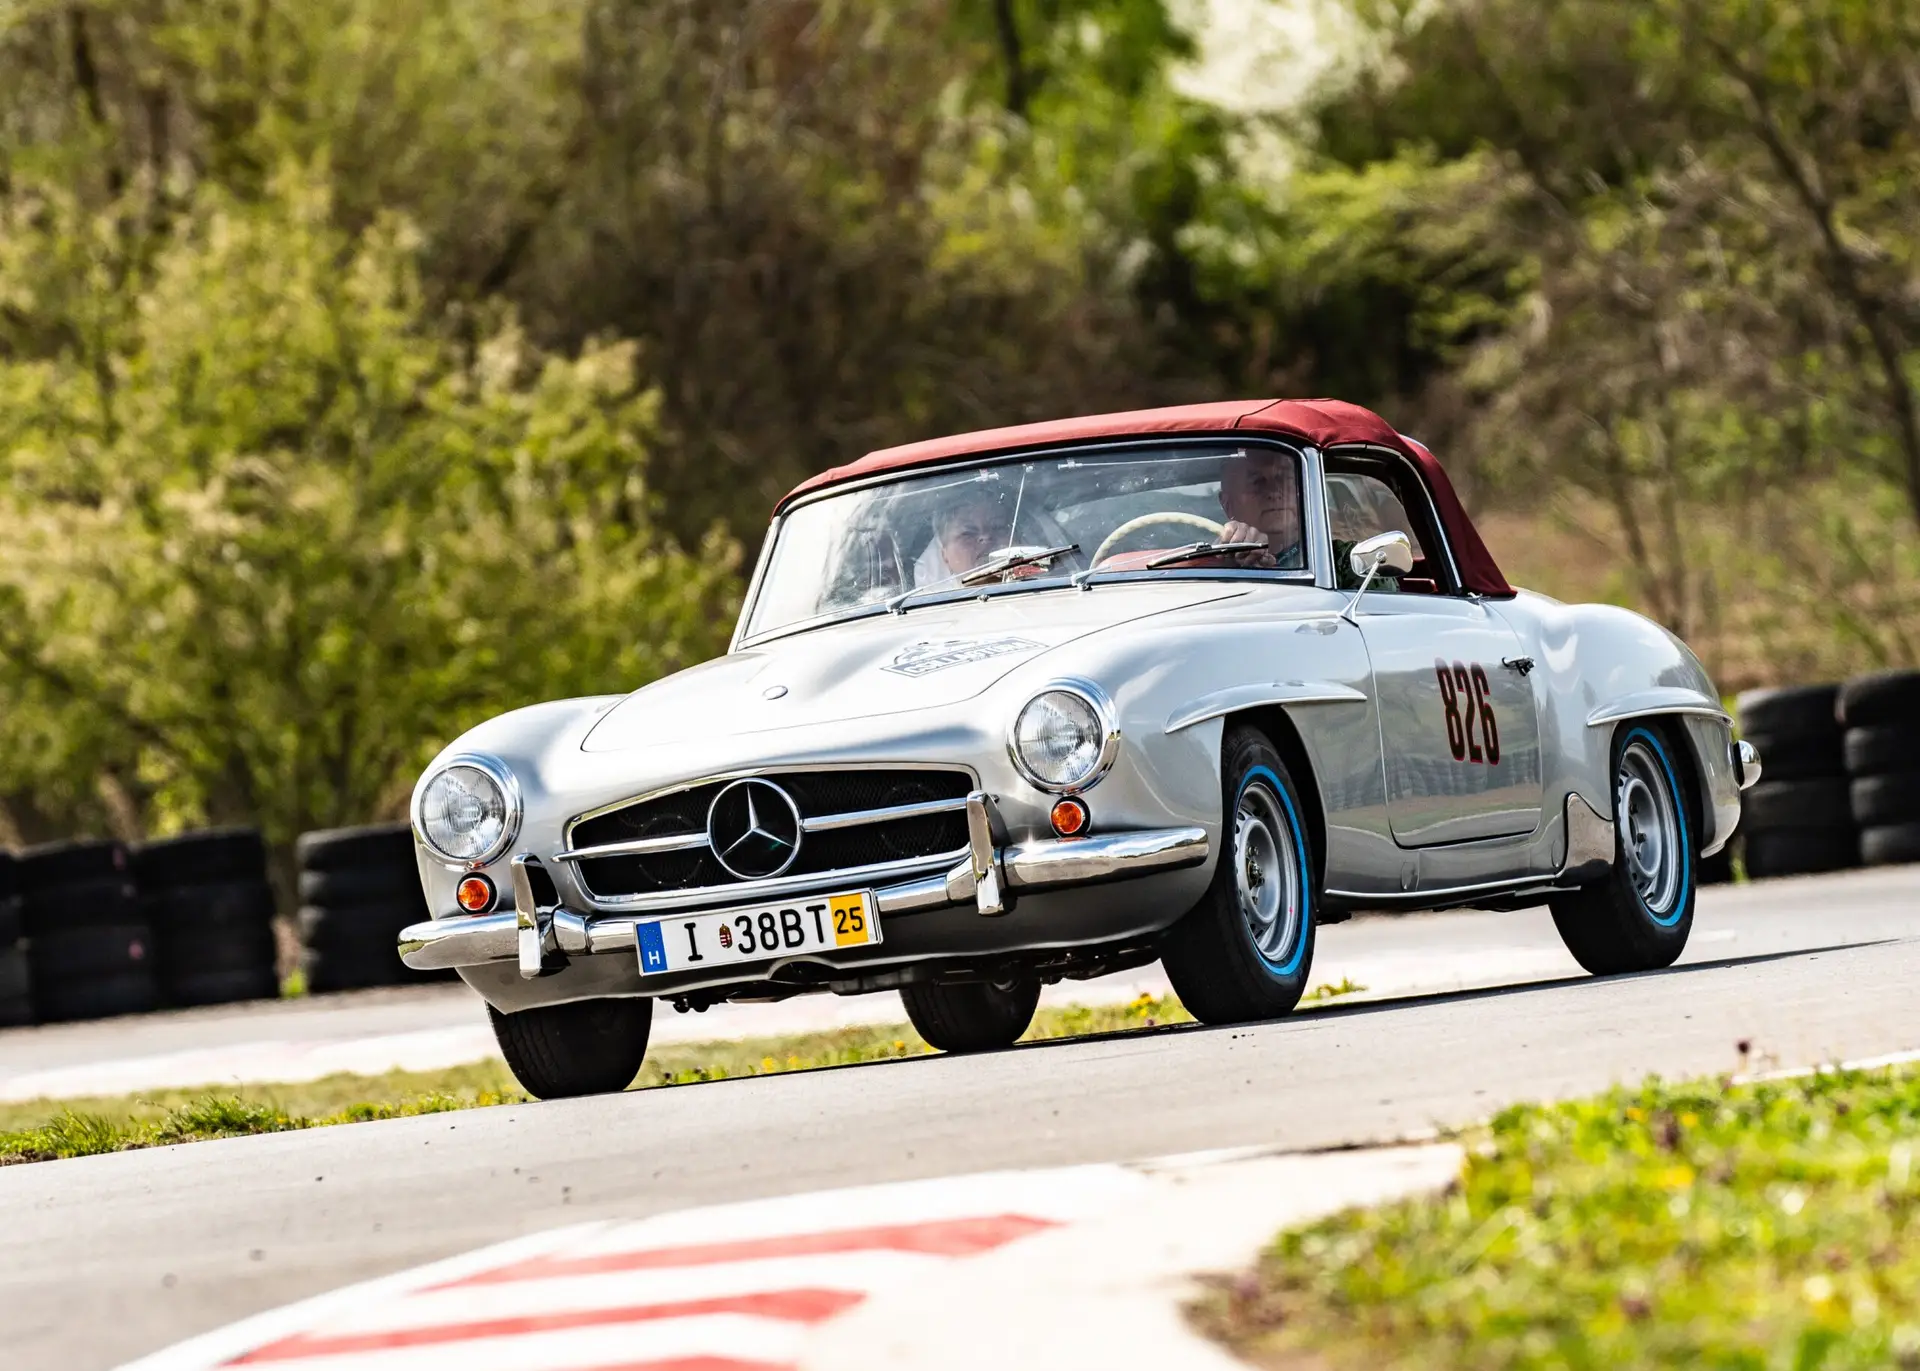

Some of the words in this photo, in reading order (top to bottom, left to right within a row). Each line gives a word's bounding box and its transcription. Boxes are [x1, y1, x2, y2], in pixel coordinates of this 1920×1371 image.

[1434, 657, 1500, 766] 826
[648, 951, 661, 966] H
[684, 922, 703, 962] I
[734, 904, 827, 954] 38BT
[834, 906, 864, 935] 25
